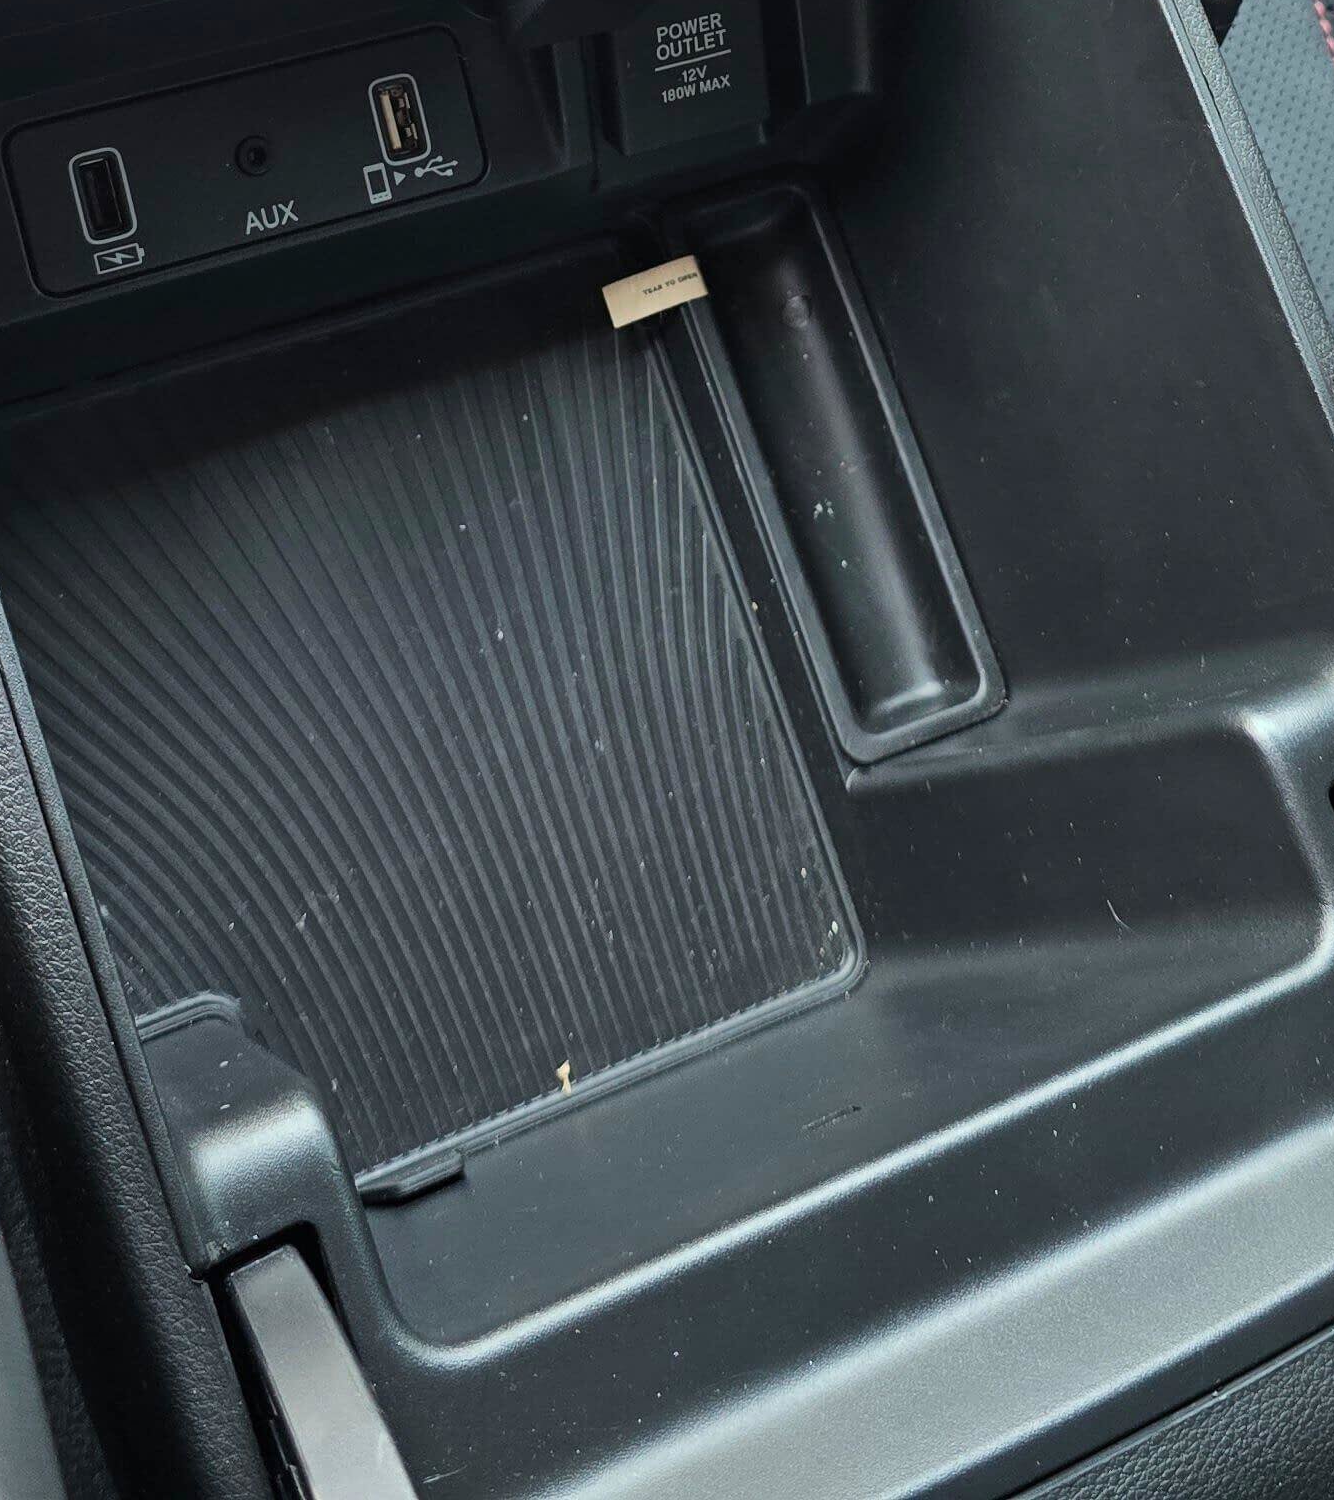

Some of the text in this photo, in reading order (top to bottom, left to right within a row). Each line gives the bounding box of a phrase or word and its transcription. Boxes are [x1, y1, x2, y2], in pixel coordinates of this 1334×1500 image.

[657, 12, 723, 43] POWER
[656, 29, 727, 61] OUTLET
[662, 74, 731, 103] 180W MAX
[682, 64, 707, 83] 12V
[245, 200, 299, 235] AUX
